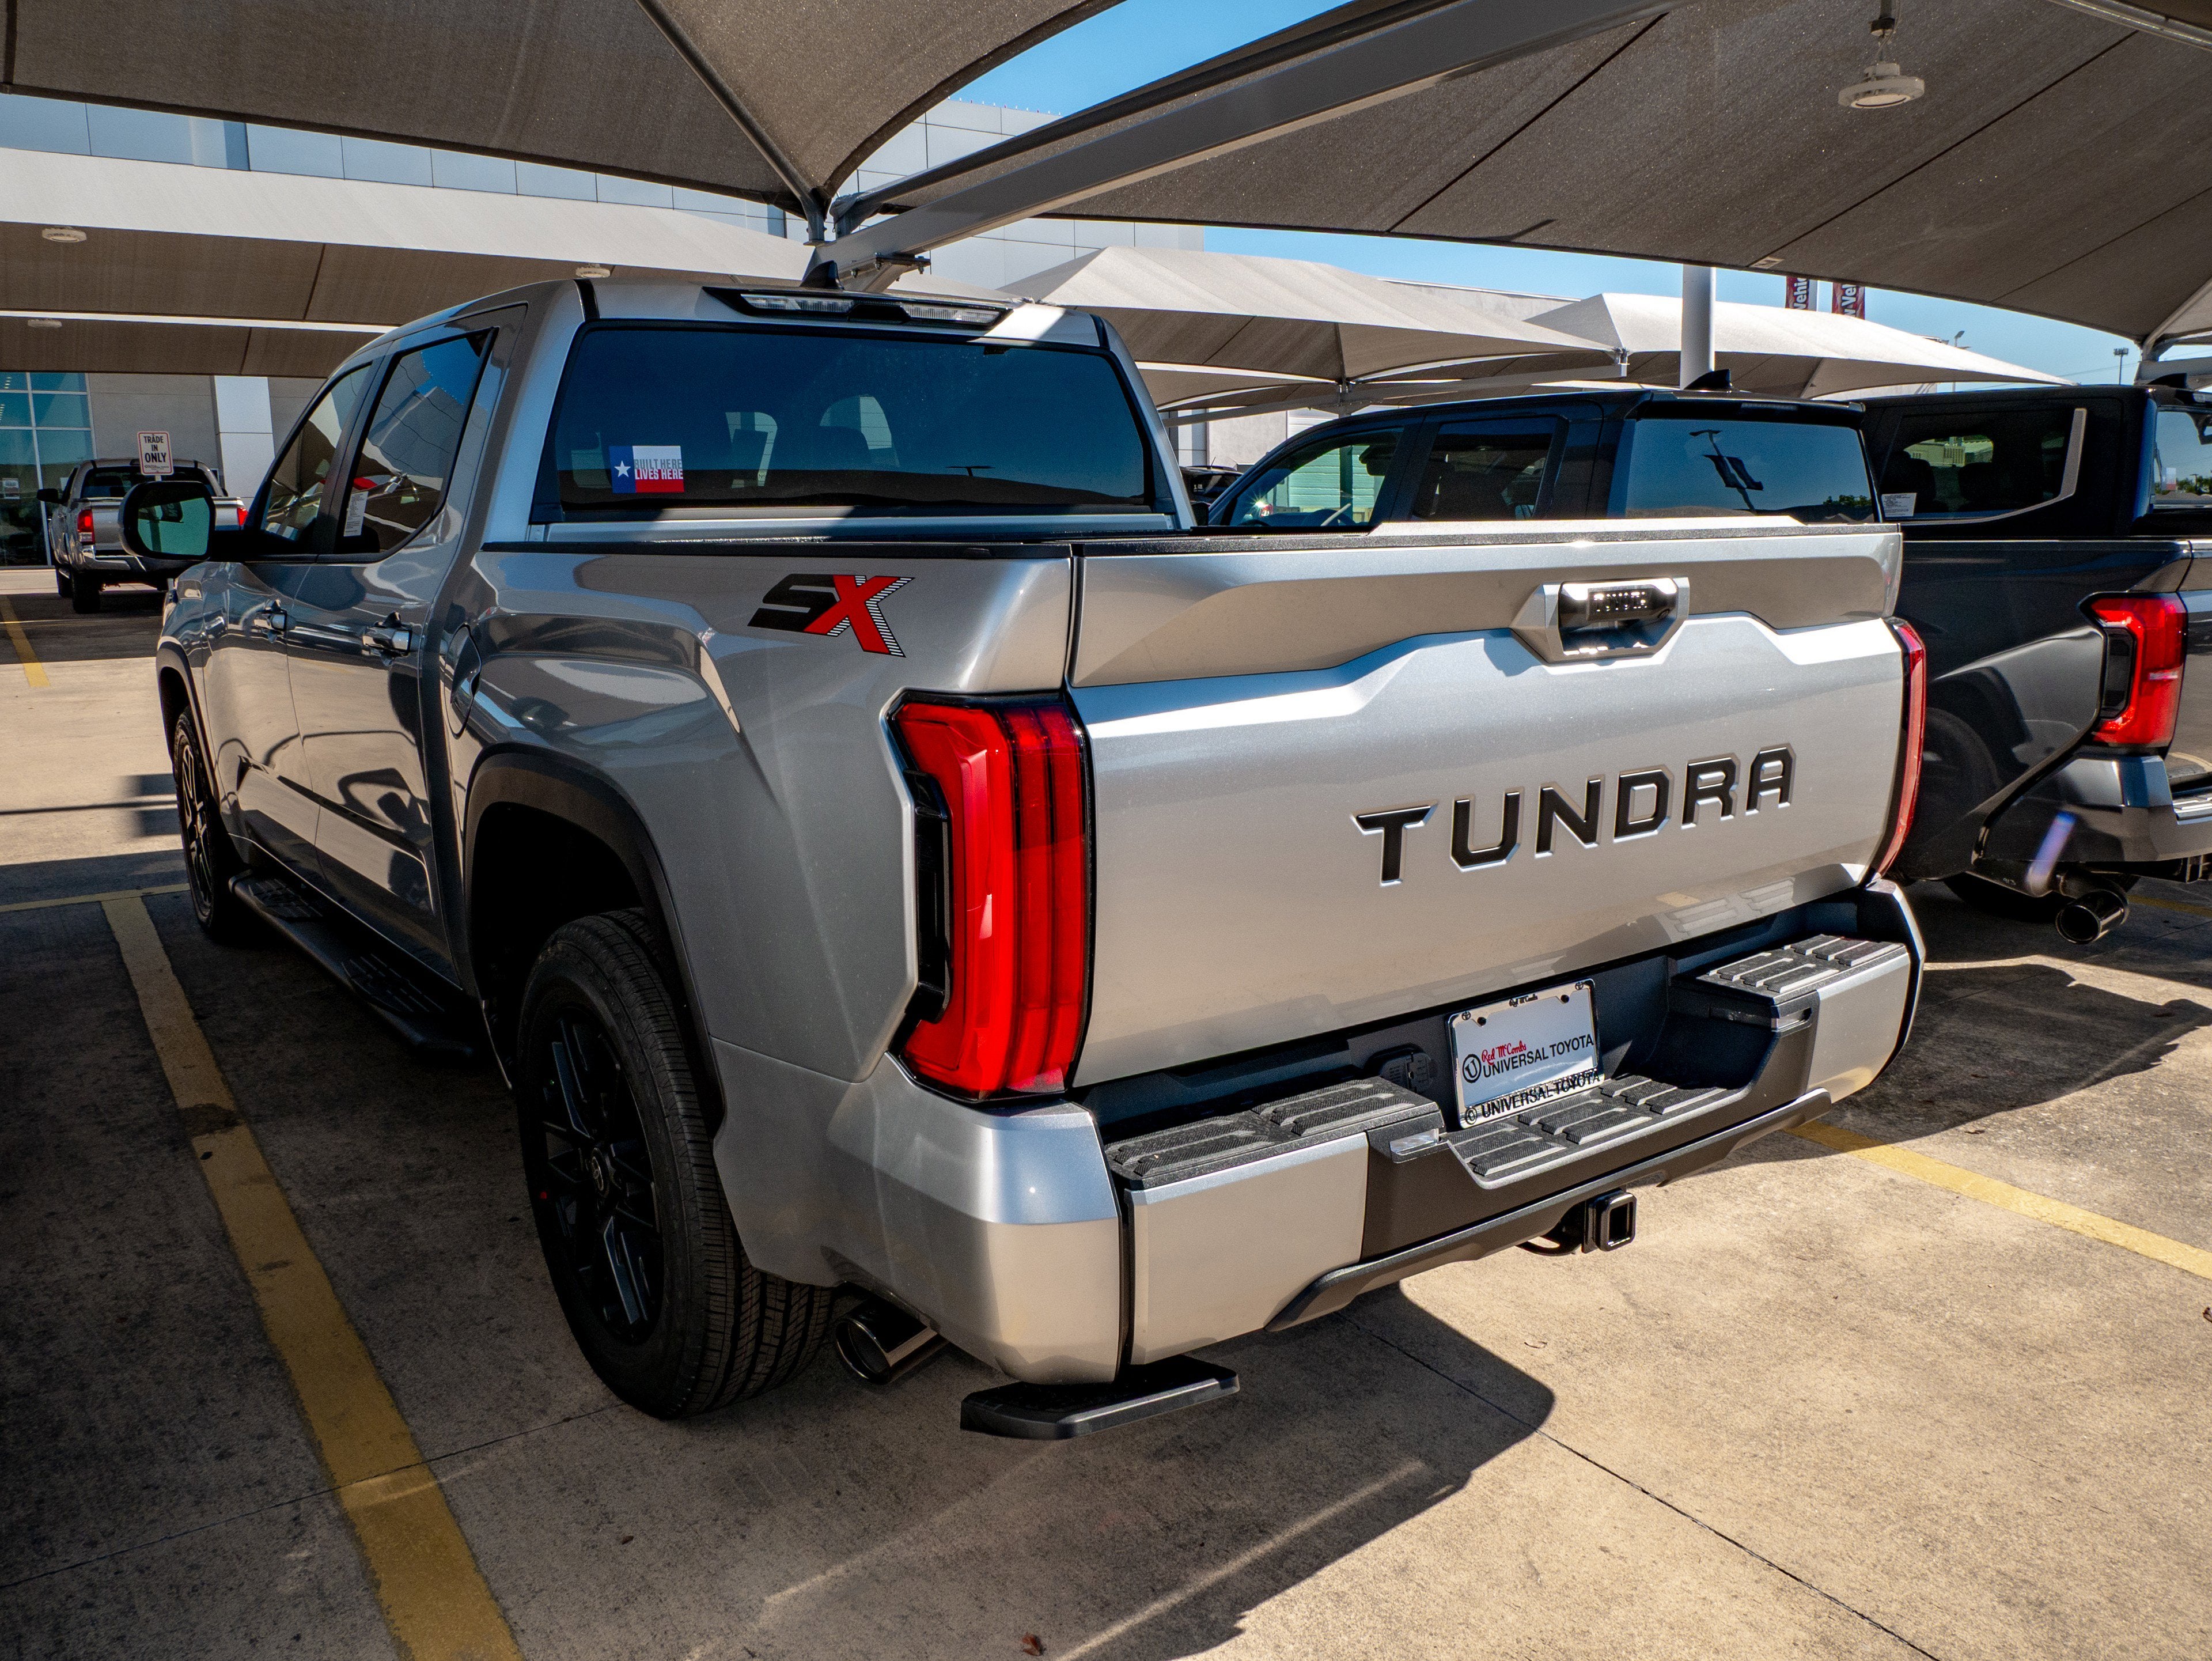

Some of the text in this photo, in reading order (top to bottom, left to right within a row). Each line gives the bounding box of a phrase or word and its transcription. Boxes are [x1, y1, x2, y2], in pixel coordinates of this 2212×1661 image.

[145, 452, 166, 463] ONLY
[634, 459, 682, 470] BUILT HERE
[634, 469, 683, 480] LIVES HERE
[1349, 743, 1797, 887] TUNDRA
[1482, 1048, 1495, 1066] Red
[1483, 1050, 1548, 1078] UNIVERSAL
[1550, 1034, 1594, 1057] TOYOTA
[1481, 1085, 1554, 1118] UNIVERSAL
[1554, 1069, 1600, 1094] TOYOTA
